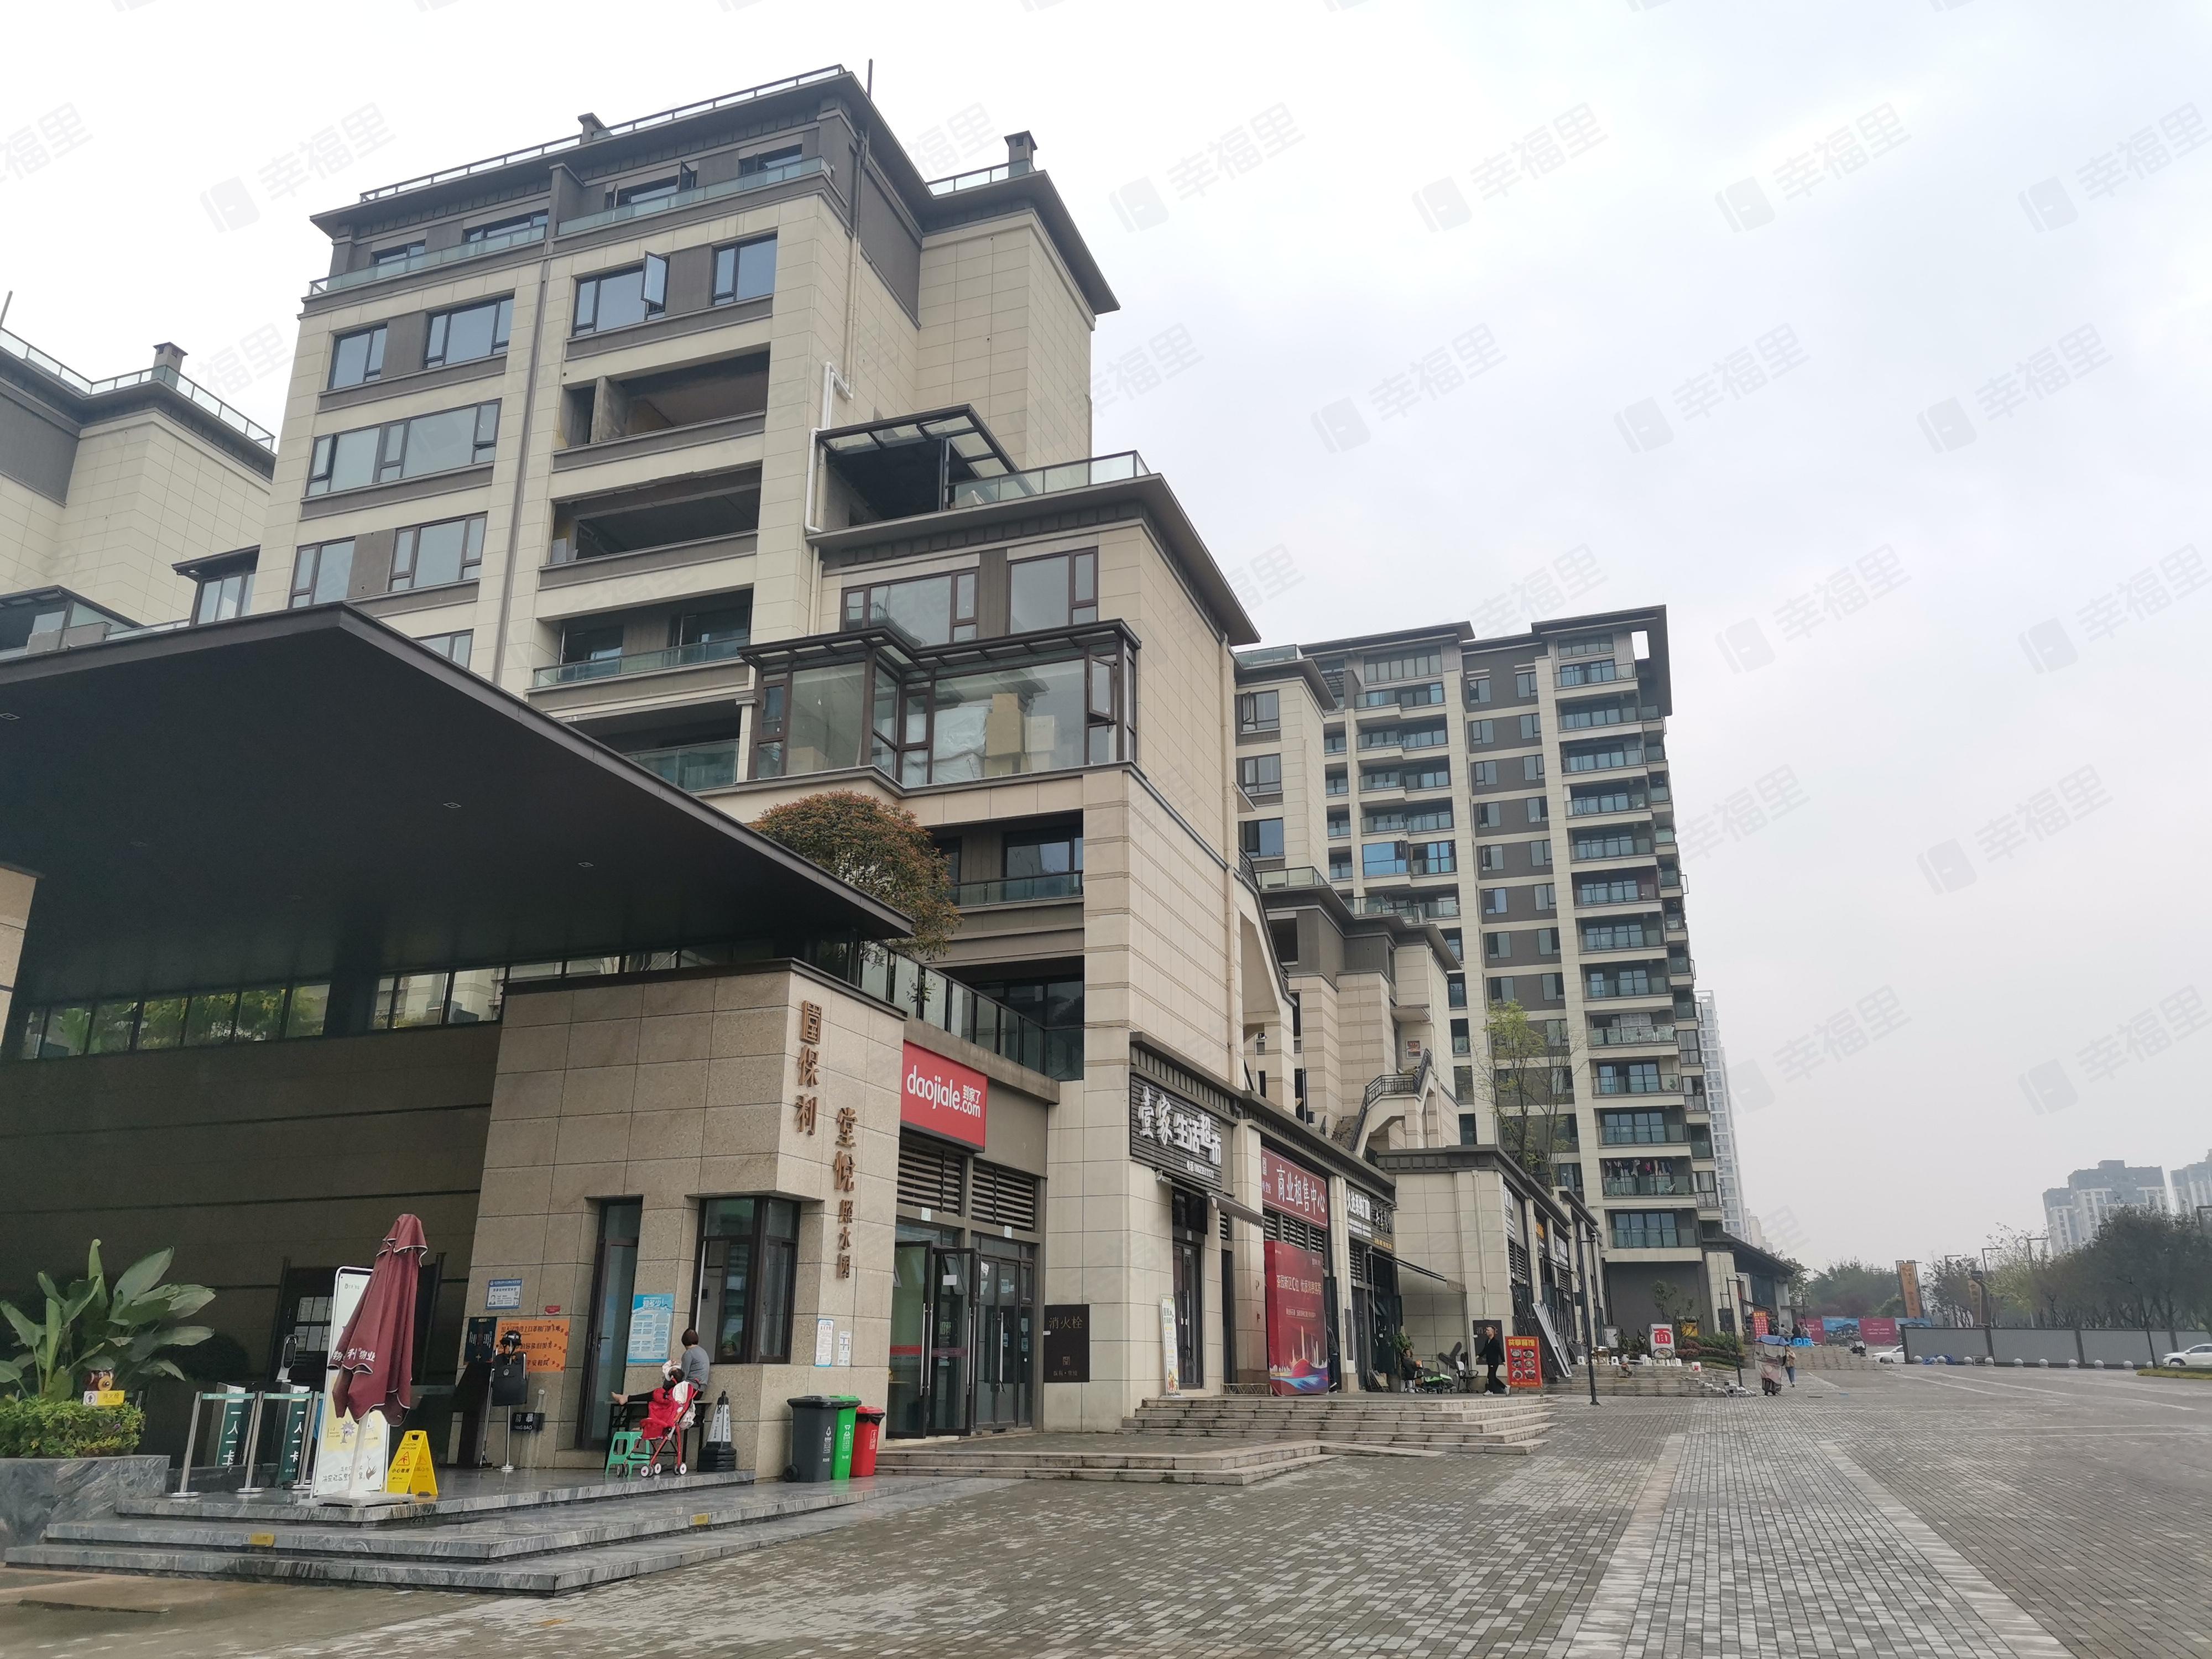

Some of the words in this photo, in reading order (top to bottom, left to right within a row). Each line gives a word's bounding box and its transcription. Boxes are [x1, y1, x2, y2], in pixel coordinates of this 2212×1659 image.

[962, 1084, 981, 1104] 到家了
[1276, 1164, 1325, 1215] 商业租售中心
[1049, 1316, 1083, 1329] 消火栓
